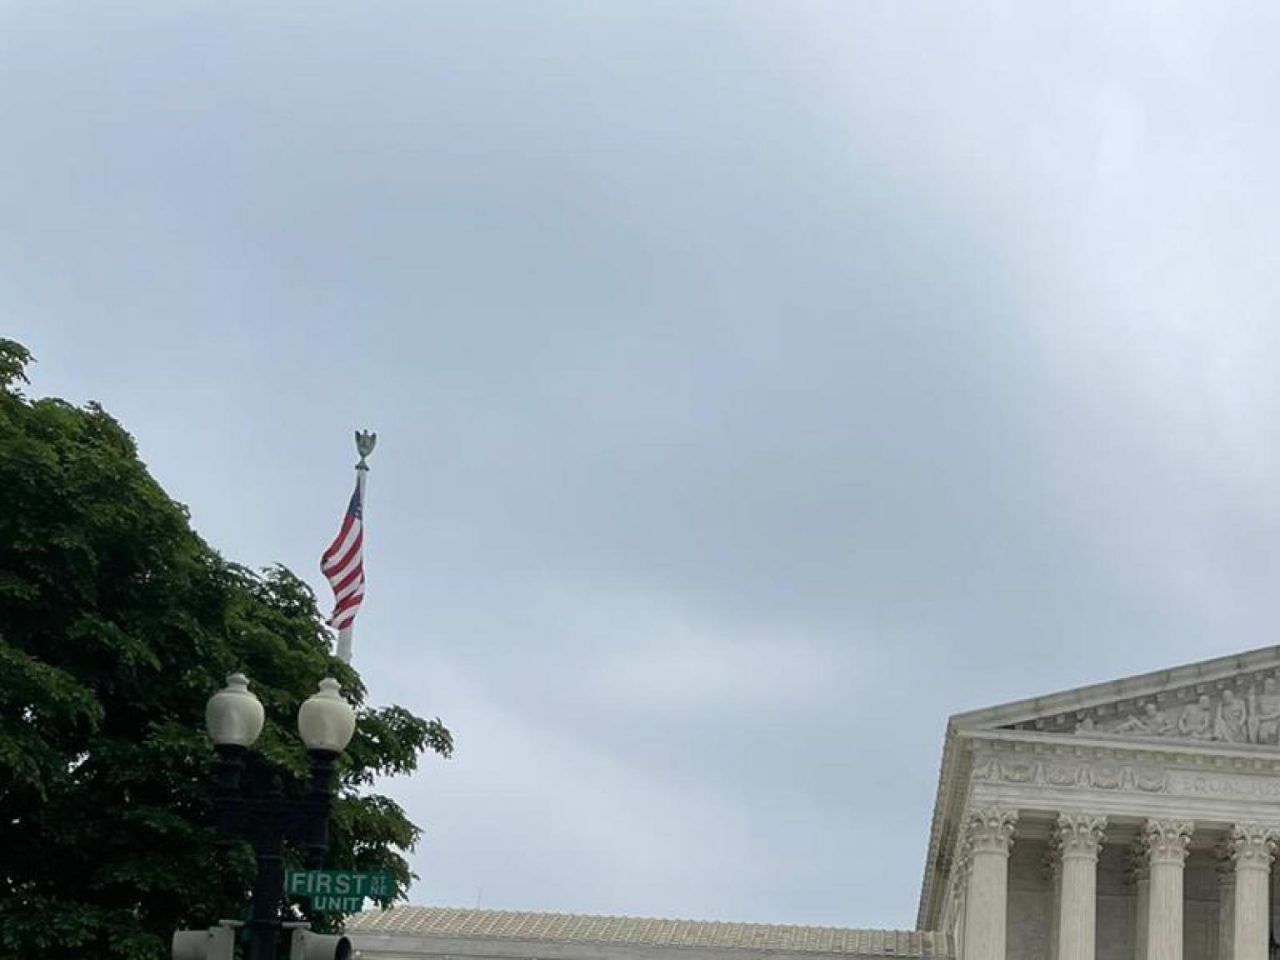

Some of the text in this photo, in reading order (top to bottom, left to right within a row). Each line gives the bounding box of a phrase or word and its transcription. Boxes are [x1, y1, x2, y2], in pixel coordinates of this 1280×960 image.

[1183, 776, 1242, 795] EQUAL
[292, 872, 367, 895] FIRST
[314, 896, 361, 911] UNIT
